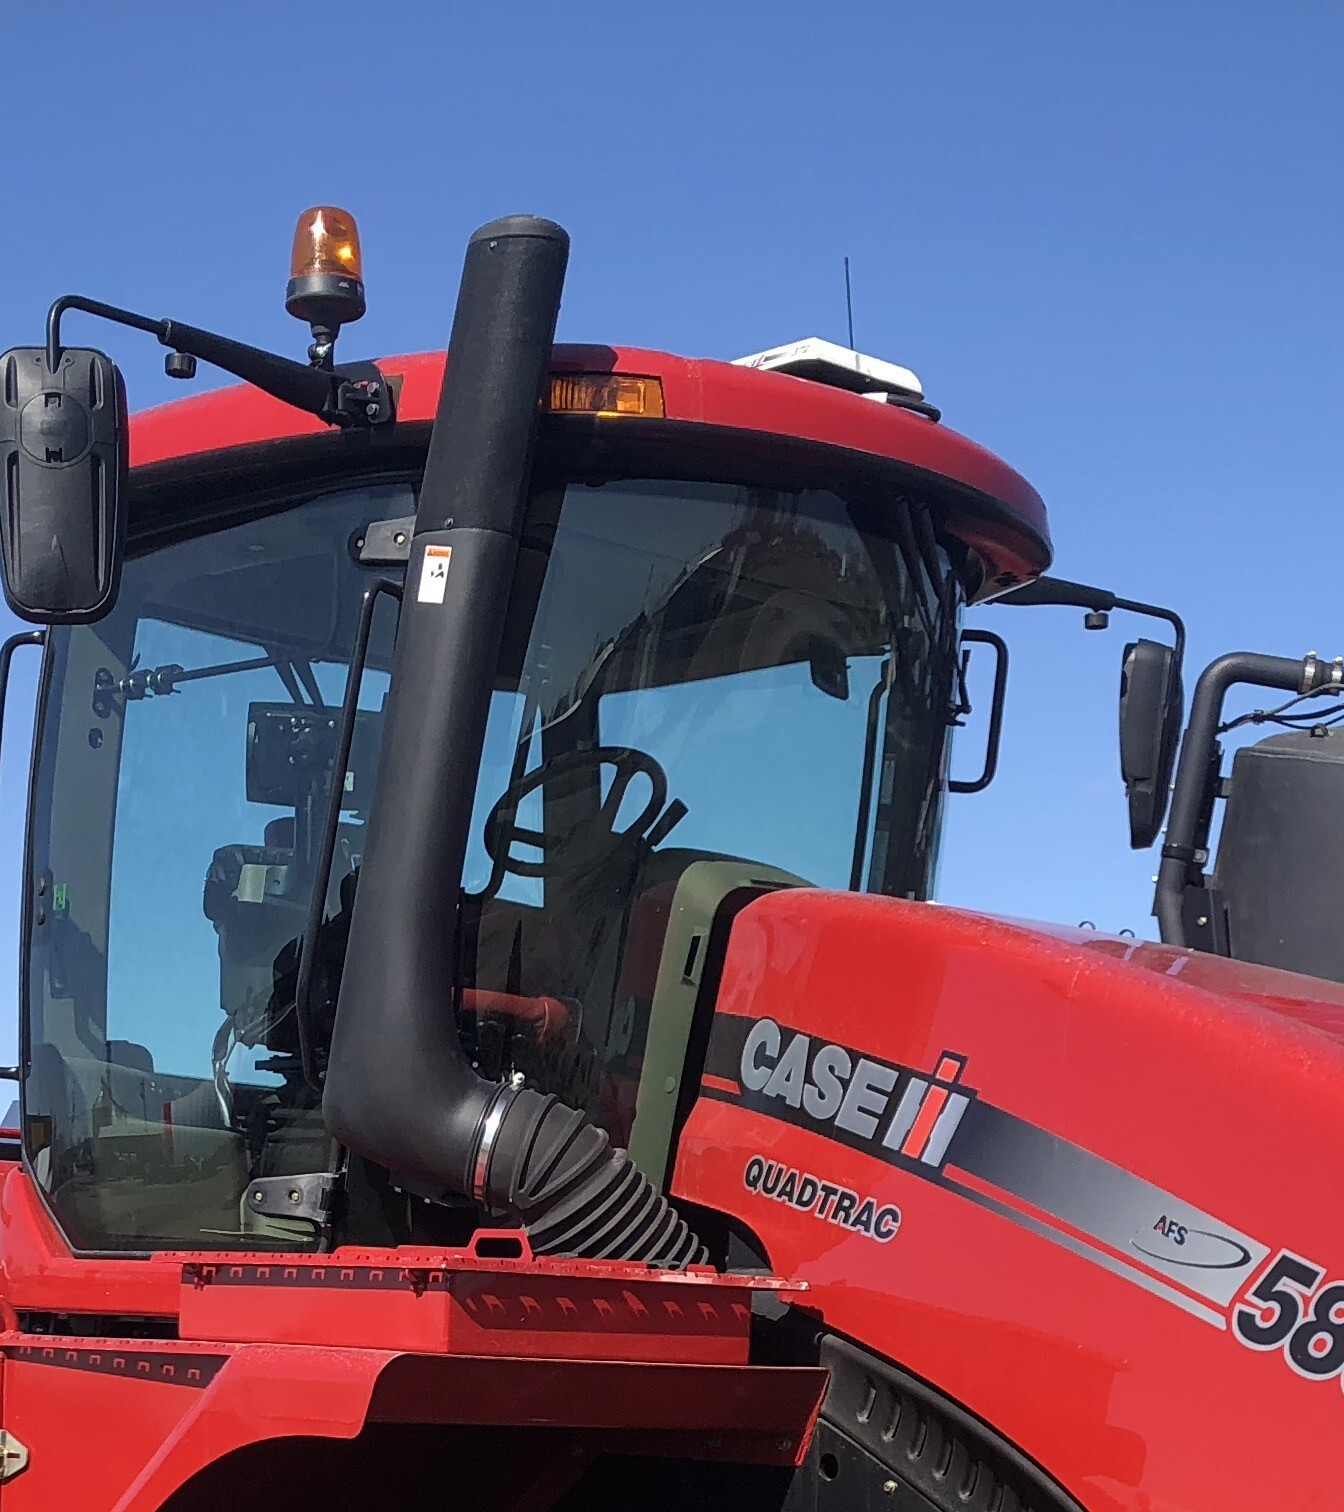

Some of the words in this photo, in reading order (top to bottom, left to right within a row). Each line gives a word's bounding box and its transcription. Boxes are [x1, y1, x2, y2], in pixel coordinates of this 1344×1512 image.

[741, 1018, 899, 1139] CASE
[744, 1155, 902, 1243] QUADTRAC
[1152, 1214, 1189, 1247] AFS
